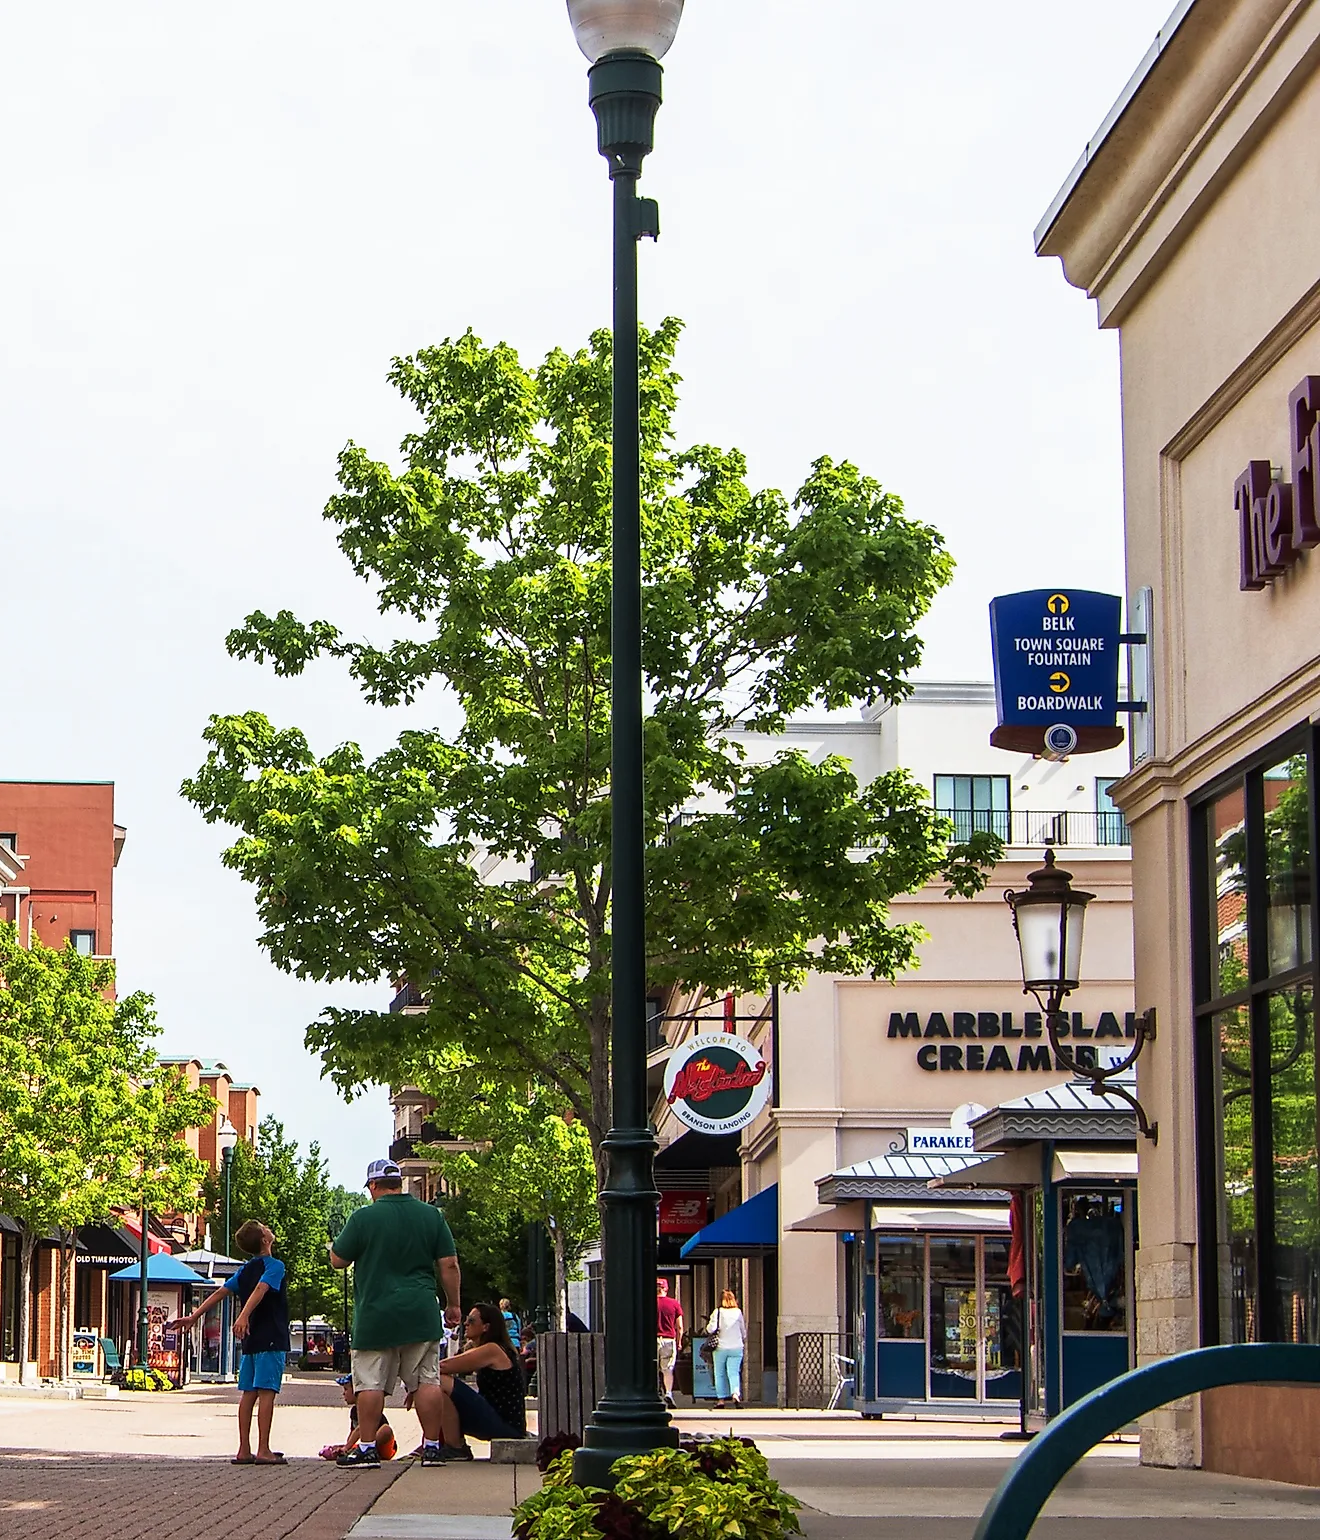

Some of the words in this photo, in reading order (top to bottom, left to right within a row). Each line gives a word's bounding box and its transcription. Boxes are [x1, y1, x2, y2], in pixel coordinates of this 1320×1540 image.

[1234, 460, 1300, 591] The
[1288, 375, 1320, 549] F
[1042, 616, 1076, 631] BELK
[1014, 638, 1052, 651] TOWN
[1055, 638, 1105, 651] SQUARE
[1027, 652, 1092, 666] FOUNTAIN
[1017, 696, 1104, 710] BOARDWALK
[887, 1012, 1043, 1038] MARBLE
[688, 1036, 732, 1051] WELCOME
[735, 1042, 747, 1052] TO
[916, 1044, 1096, 1072] CREAMER
[696, 1059, 711, 1072] The
[681, 1110, 716, 1131] BRANSON
[719, 1111, 752, 1131] LANDING
[913, 1136, 973, 1149] PARAKEE
[76, 1256, 90, 1264] OLD
[91, 1256, 107, 1264] TIME
[108, 1256, 138, 1264] PHOTOS
